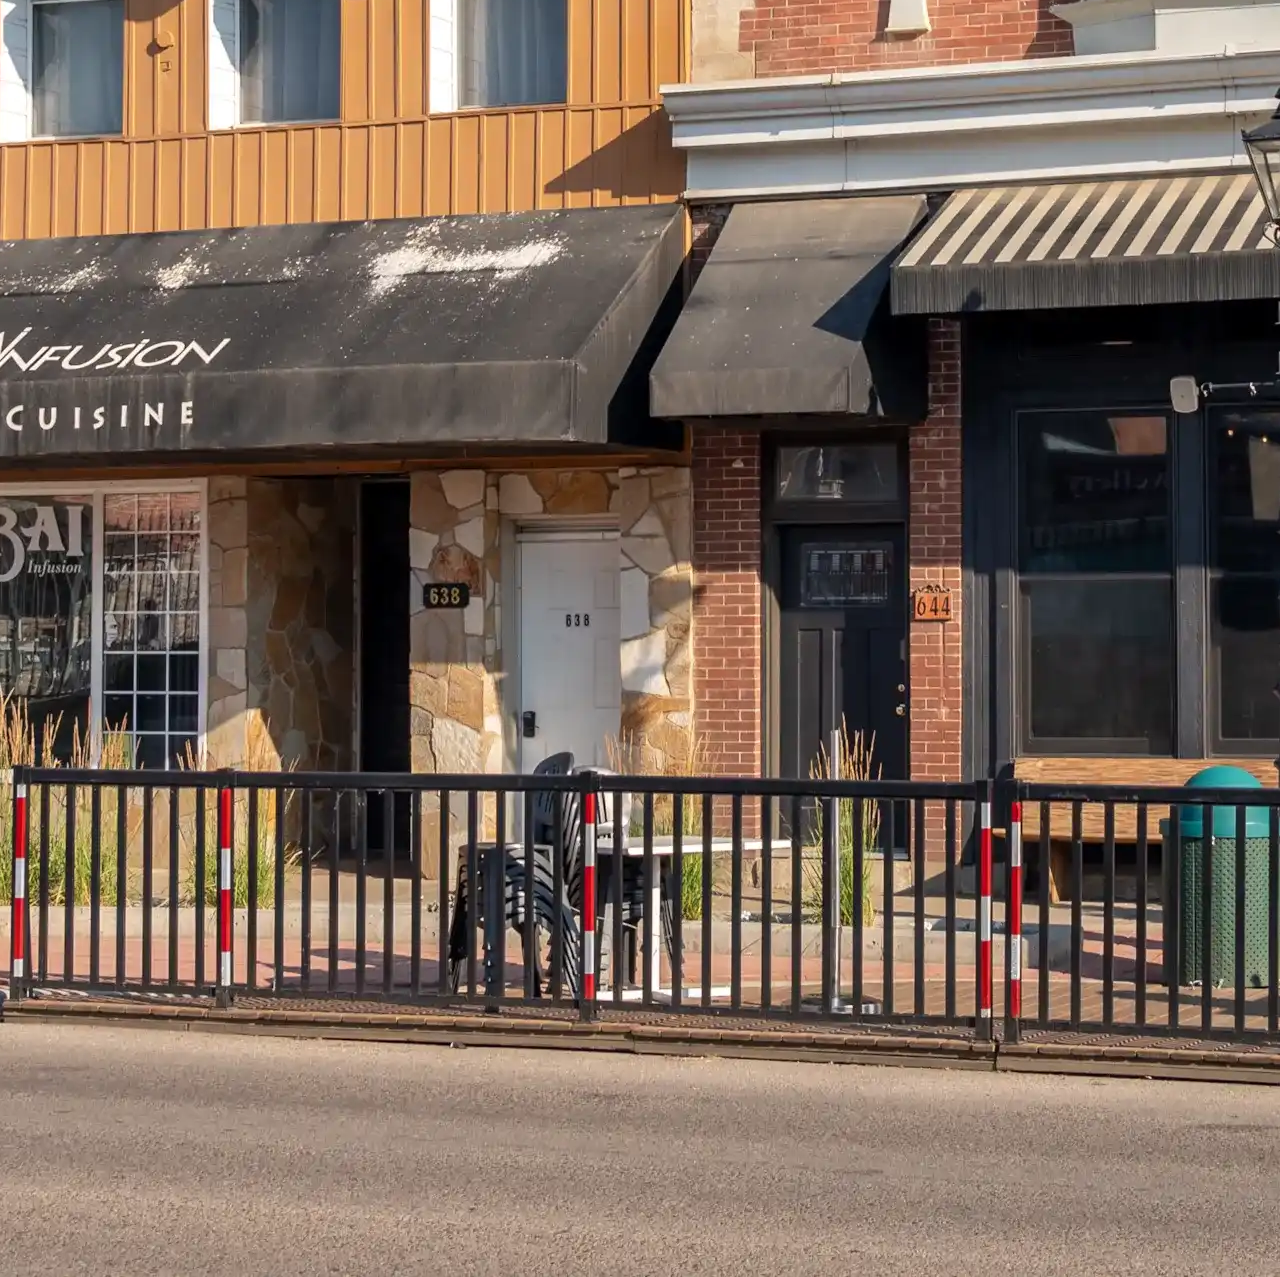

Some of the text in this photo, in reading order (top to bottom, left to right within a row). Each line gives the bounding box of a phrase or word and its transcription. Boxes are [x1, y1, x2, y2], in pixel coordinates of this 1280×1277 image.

[5, 400, 194, 431] CUISINE
[26, 559, 82, 578] Infusion
[428, 587, 461, 605] 638
[916, 596, 951, 617] 644
[565, 613, 590, 627] 638
